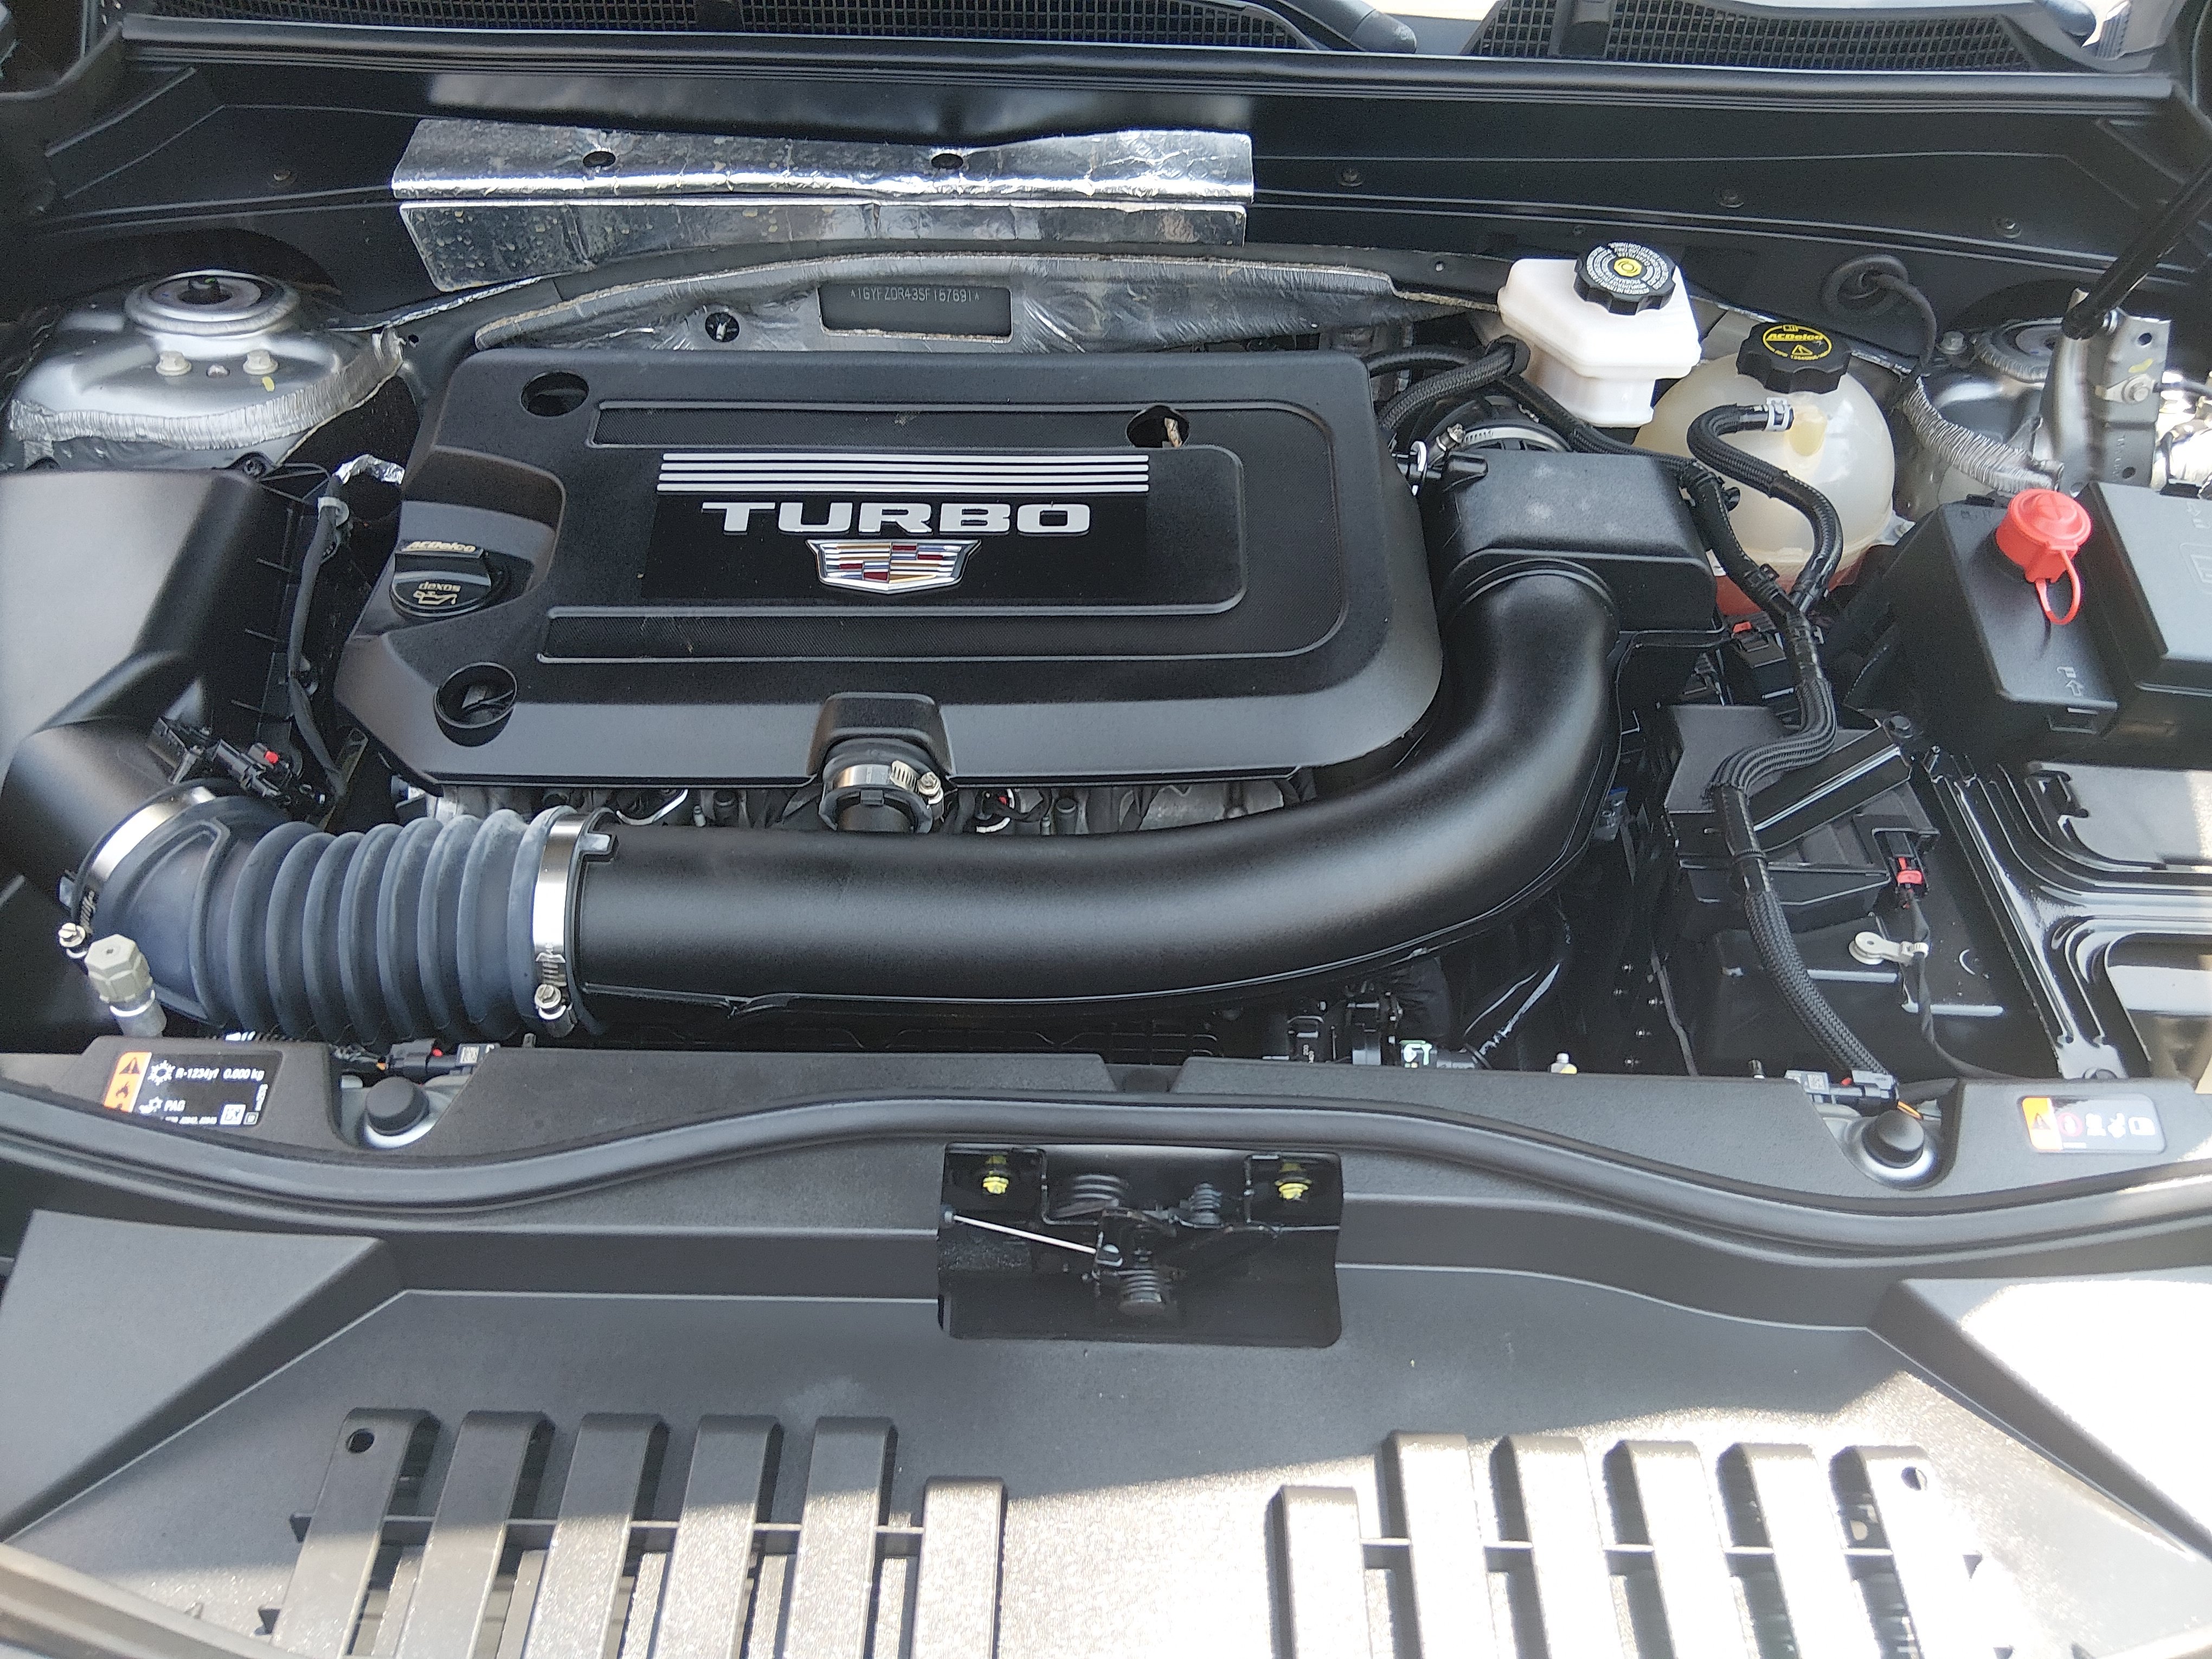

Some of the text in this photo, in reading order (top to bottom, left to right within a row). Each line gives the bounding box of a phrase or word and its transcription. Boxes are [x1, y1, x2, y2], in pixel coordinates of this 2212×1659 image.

[1766, 333, 1824, 342] ACDelco
[701, 501, 1090, 537] TURBO
[418, 581, 462, 593] dexos
[250, 1068, 265, 1081] kg
[164, 1100, 185, 1111] PAG
